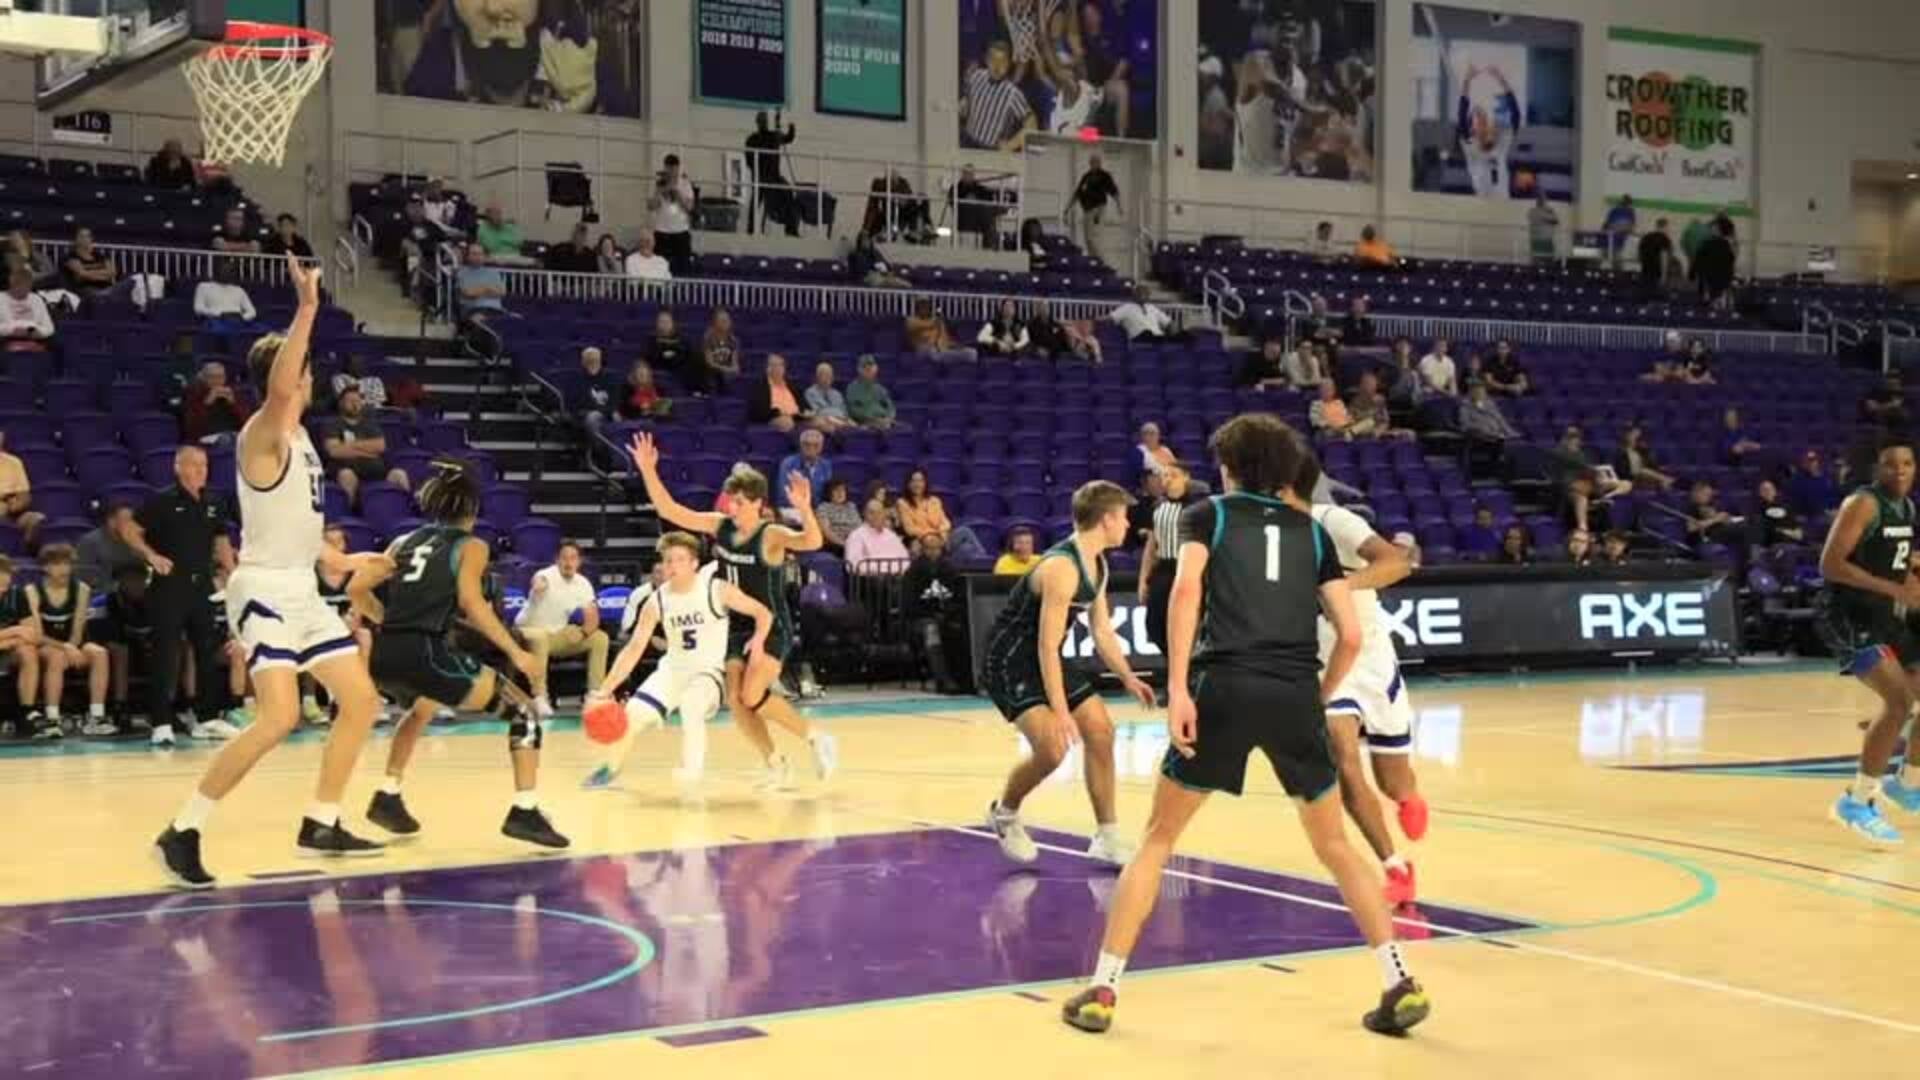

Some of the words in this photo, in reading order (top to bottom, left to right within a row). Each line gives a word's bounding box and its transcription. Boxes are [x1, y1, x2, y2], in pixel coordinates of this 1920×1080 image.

[1605, 74, 1747, 115] CROWTHER
[1616, 110, 1733, 145] ROOFING
[403, 545, 433, 582] 5
[1264, 525, 1281, 581] 1
[670, 612, 705, 629] IMG
[1375, 598, 1463, 646] XE
[1580, 592, 1706, 638] AXE
[682, 629, 697, 650] 5
